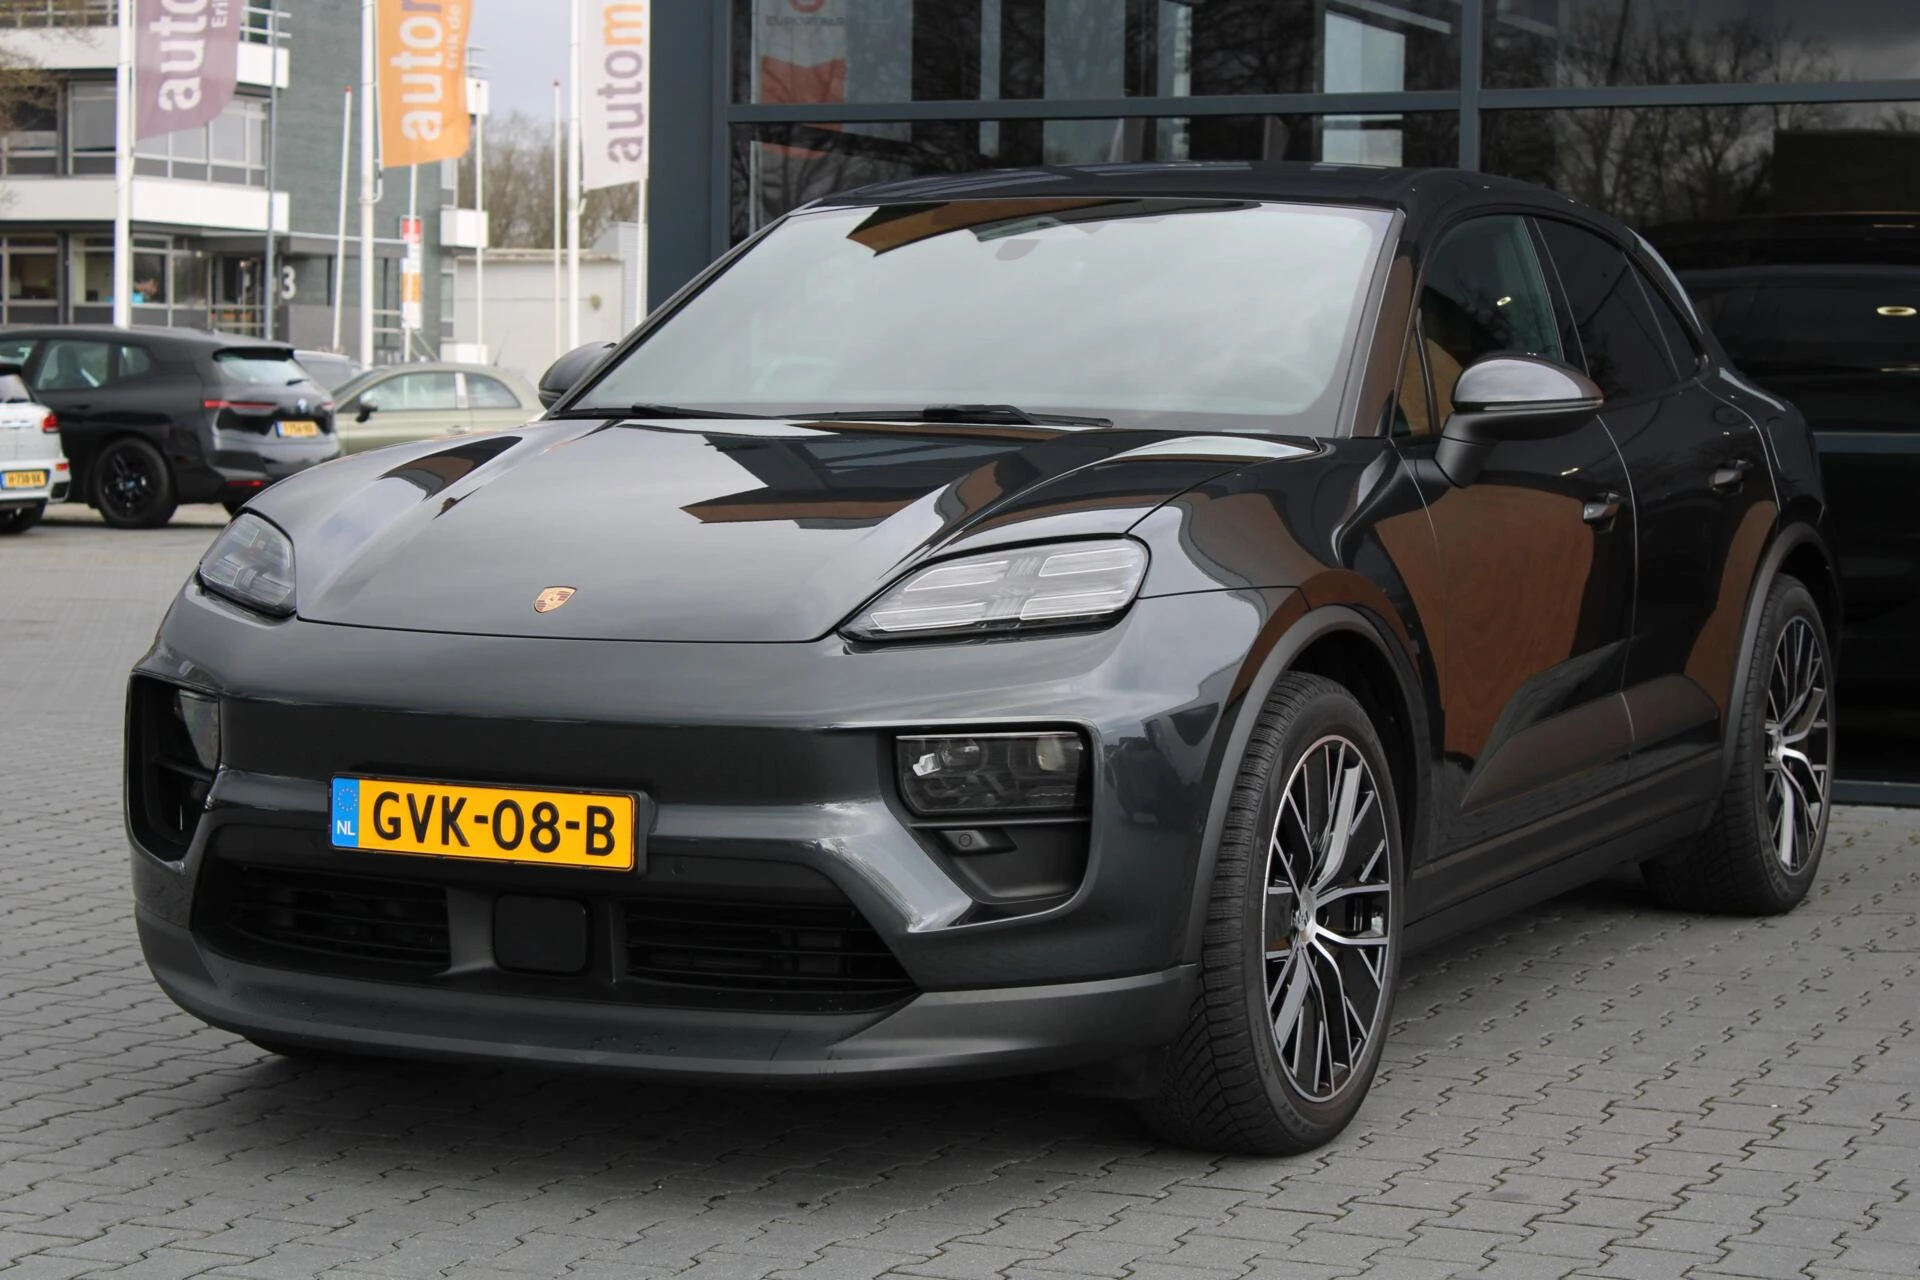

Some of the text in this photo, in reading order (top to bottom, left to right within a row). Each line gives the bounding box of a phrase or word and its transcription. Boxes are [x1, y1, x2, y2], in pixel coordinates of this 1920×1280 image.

[211, 0, 227, 28] Eri
[446, 5, 461, 71] Erik de
[597, 3, 643, 164] autom
[281, 265, 296, 299] 3
[336, 819, 356, 836] NL
[372, 790, 616, 857] GVK-08-B
